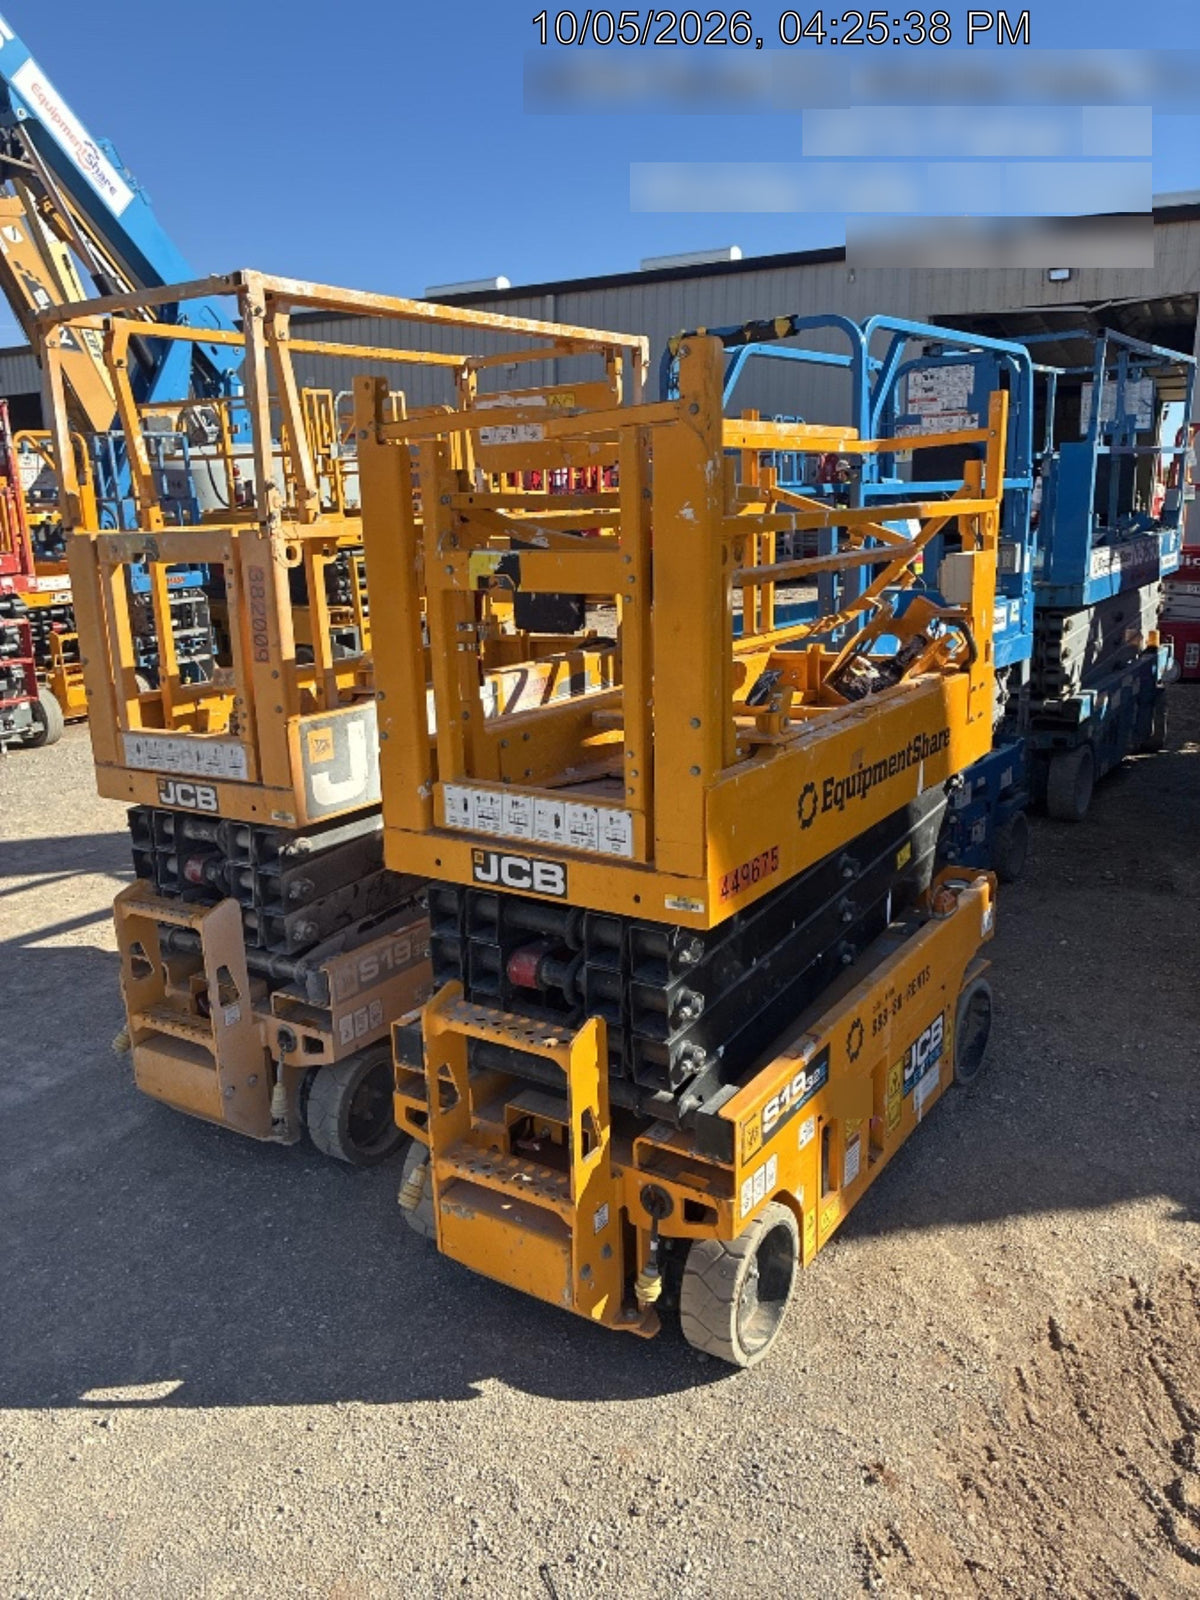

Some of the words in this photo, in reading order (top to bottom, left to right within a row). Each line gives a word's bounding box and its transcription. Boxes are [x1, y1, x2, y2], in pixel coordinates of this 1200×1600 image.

[248, 565, 269, 663] 382009
[159, 781, 217, 810] JCB
[821, 726, 950, 812] EquipmentShare
[475, 853, 566, 896] JCB
[720, 846, 779, 900] 449675
[904, 1014, 944, 1082] JCB
